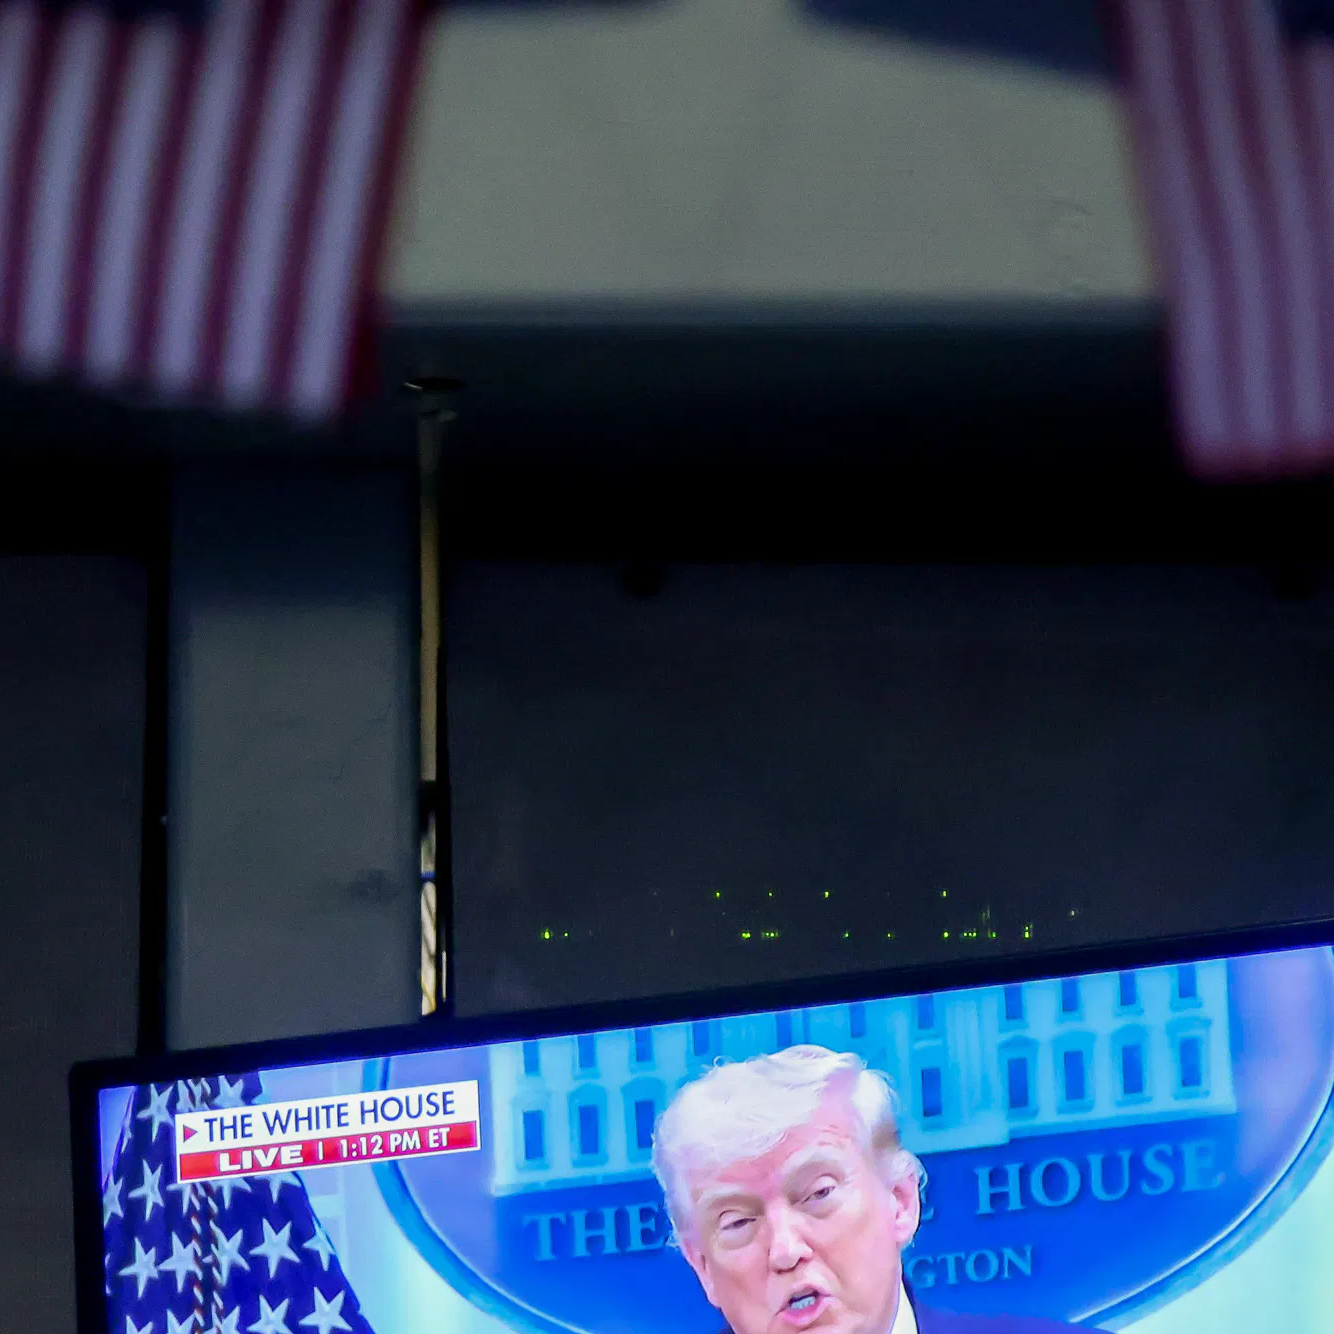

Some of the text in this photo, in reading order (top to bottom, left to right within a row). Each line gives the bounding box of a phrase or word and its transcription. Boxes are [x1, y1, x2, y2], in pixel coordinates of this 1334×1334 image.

[204, 1090, 456, 1142] THE WHITE HOUSE
[219, 1127, 451, 1172] LIVE 1:12 PM ET
[523, 1202, 667, 1262] THE
[973, 1140, 1227, 1216] HOUSE
[905, 1244, 1033, 1290] GTON
